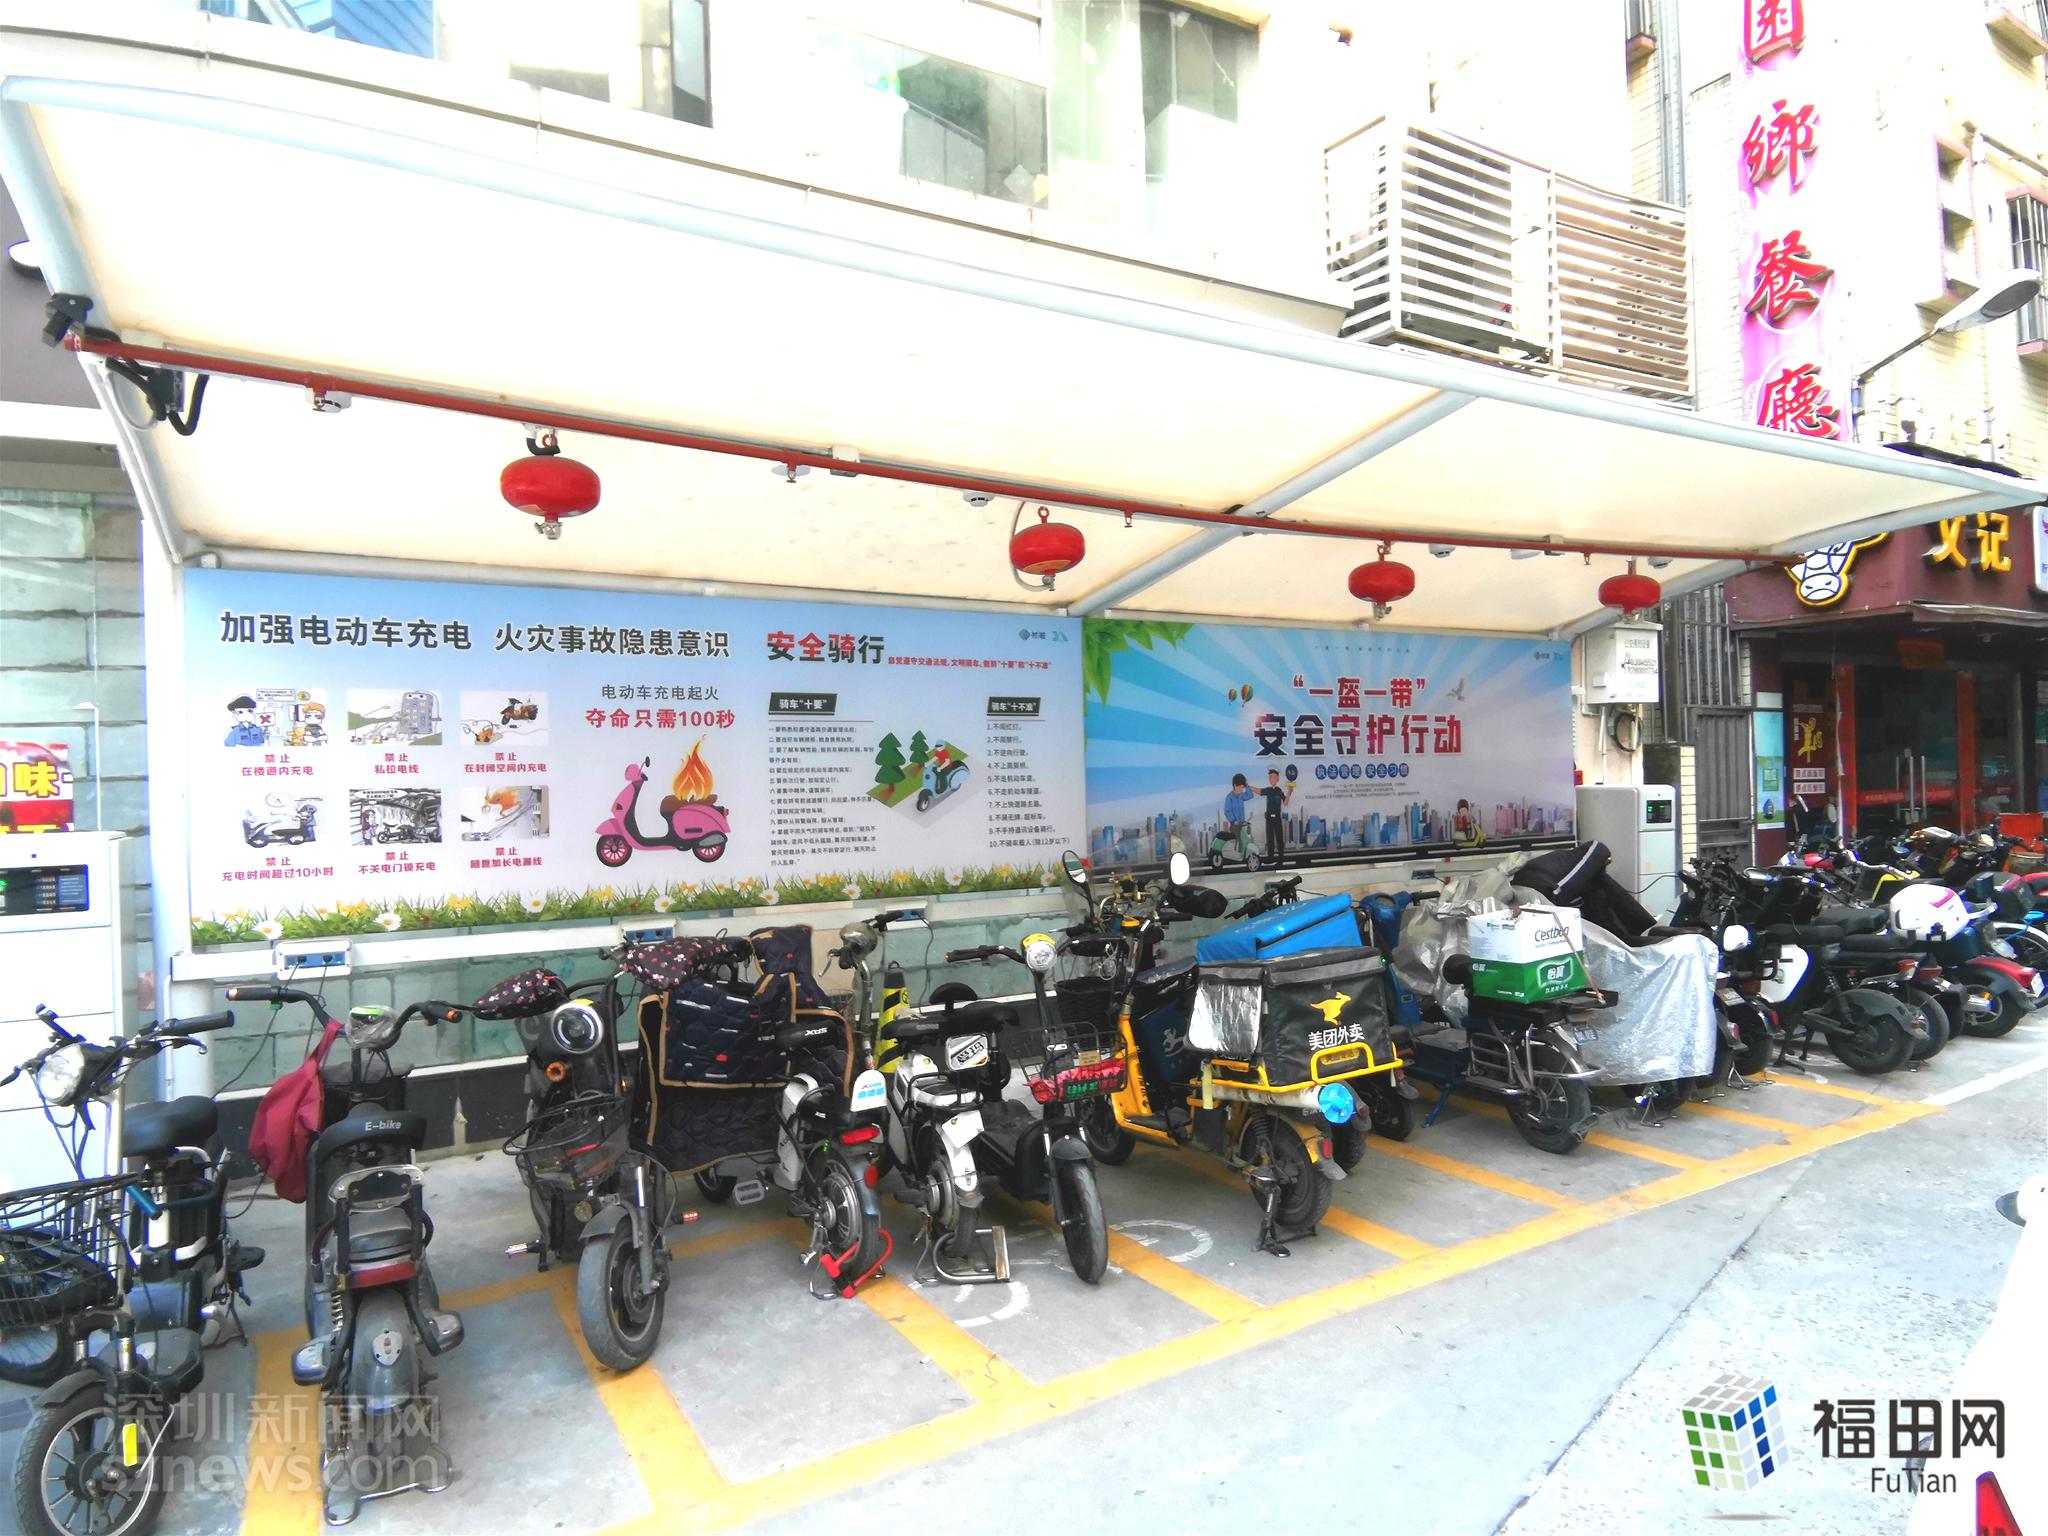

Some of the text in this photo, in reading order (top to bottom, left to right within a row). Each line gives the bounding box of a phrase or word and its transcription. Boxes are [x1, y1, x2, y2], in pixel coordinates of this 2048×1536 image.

[219, 610, 731, 659] 加强电动车充电 火灾事故隐患意识
[767, 630, 885, 664] 安全骑行
[601, 684, 720, 701] 电动车充电起火
[1293, 673, 1426, 709] “一盔一带”
[585, 707, 736, 729] 夺命只需100秒
[1254, 713, 1463, 757] 安全守护行动
[241, 766, 314, 777] 在楼道内充电
[373, 764, 420, 774] 私拉电线
[464, 762, 548, 773] 在封闭空间内充电
[221, 866, 334, 882] 充电时间超过10小时
[1307, 1023, 1365, 1051] 美团外卖
[365, 1119, 402, 1131] E-bike
